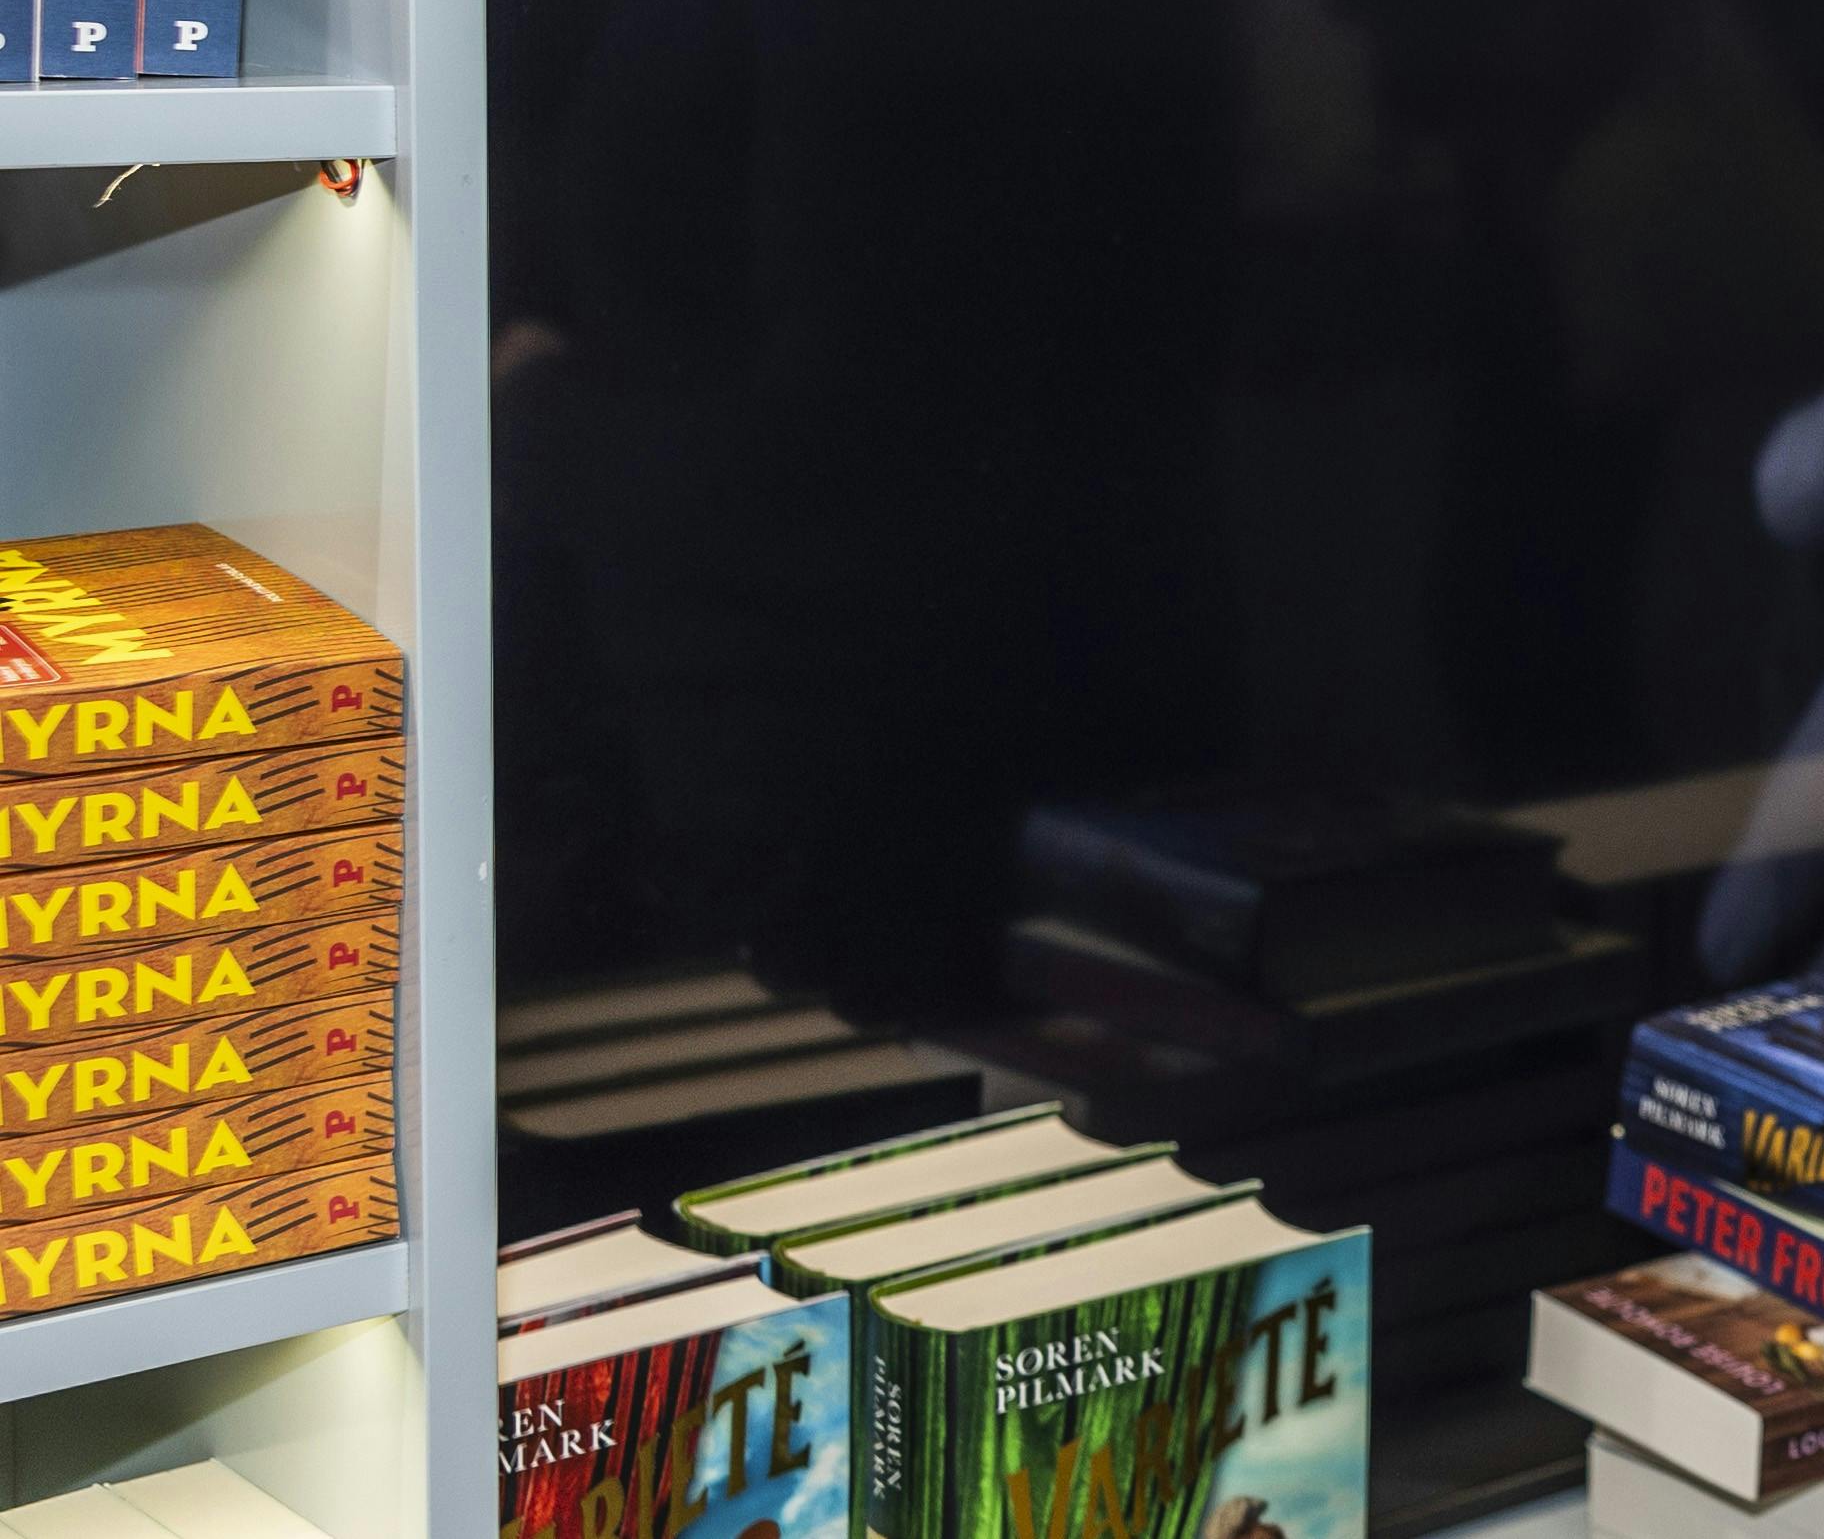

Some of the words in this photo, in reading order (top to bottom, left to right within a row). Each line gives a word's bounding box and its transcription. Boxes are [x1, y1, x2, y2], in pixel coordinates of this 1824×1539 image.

[71, 21, 108, 52] P
[172, 20, 209, 51] P
[0, 686, 257, 761] YRNA
[0, 776, 262, 859] YRNA
[0, 863, 259, 950] YRNA
[0, 948, 256, 1036] YRNA
[0, 1035, 253, 1126] YRNA
[0, 1119, 253, 1213] YRNA
[0, 1205, 258, 1306] YRNA
[1641, 1164, 1764, 1276] PETER
[995, 1327, 1120, 1382] SØREN
[995, 1346, 1166, 1416] PILMARK
[1006, 1277, 1338, 1539] VARIETÉ
